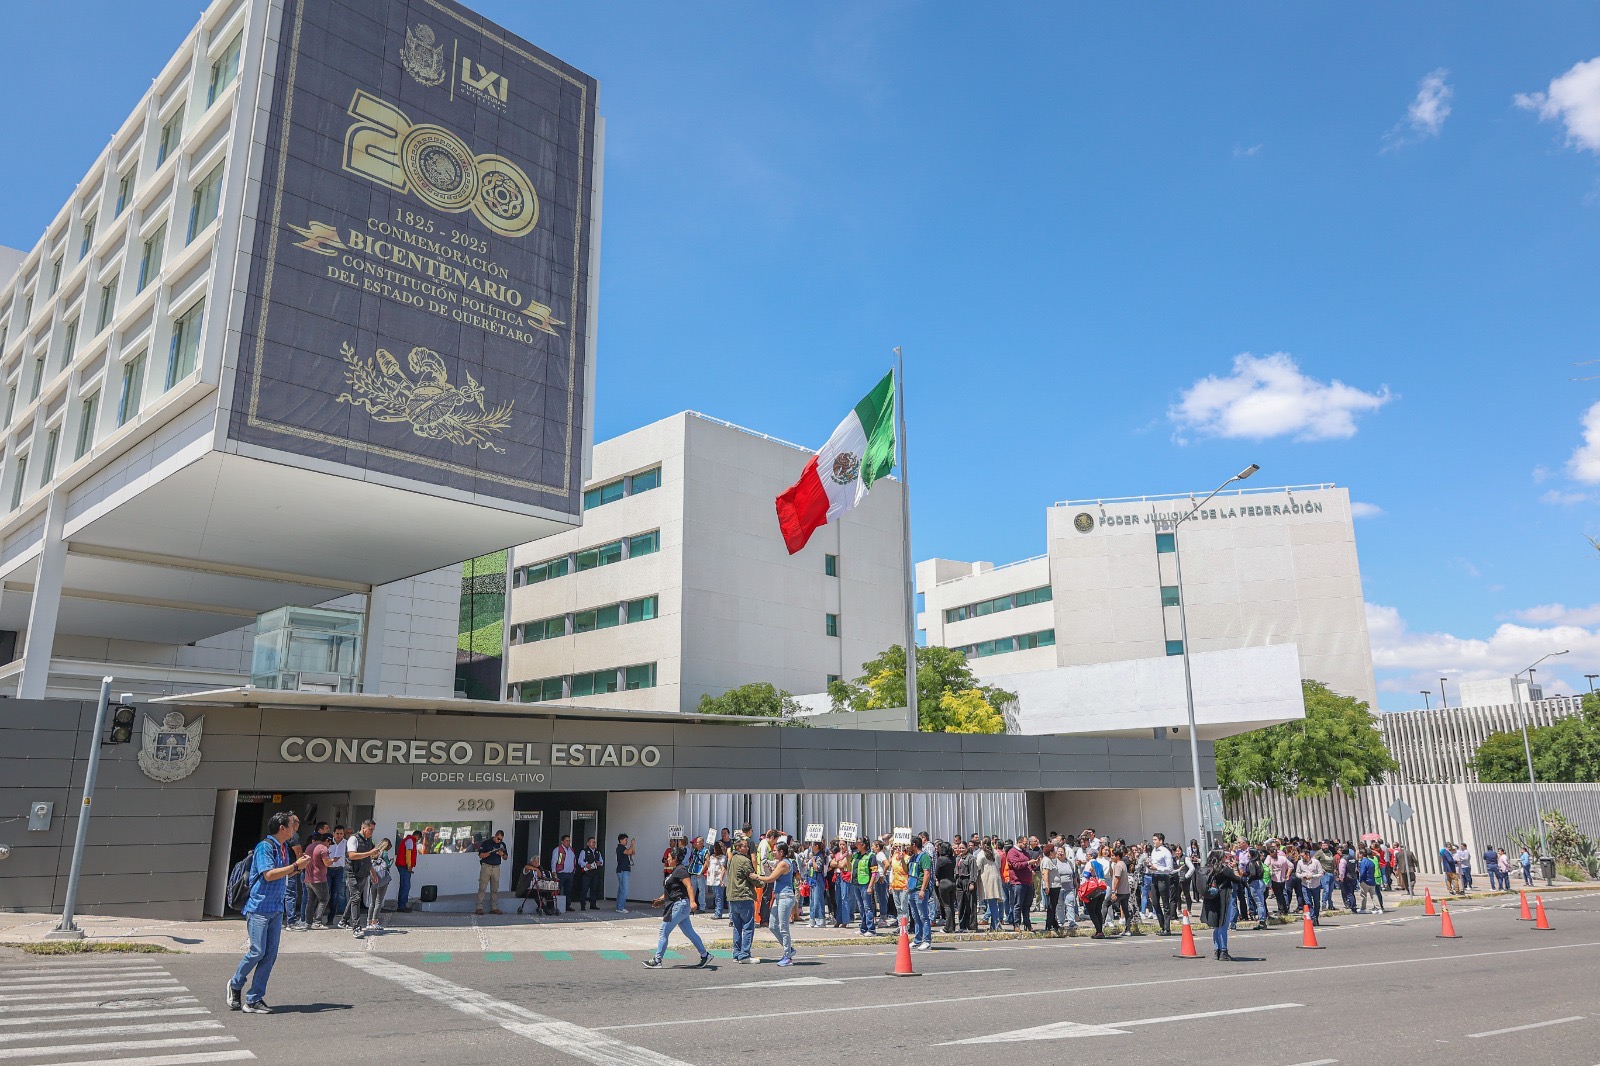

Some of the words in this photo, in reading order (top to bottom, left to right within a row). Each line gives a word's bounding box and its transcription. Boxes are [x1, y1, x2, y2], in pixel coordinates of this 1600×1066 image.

[462, 56, 508, 103] LXI
[367, 217, 509, 280] CONMEMORACIÓN
[395, 208, 434, 233] 1825
[450, 229, 488, 254] 2025
[347, 228, 522, 307] BICENTENARIO
[327, 265, 359, 287] DEL
[362, 277, 424, 307] ESTADO
[428, 300, 449, 317] DE
[452, 308, 534, 344] QUERÉTARO
[342, 255, 458, 304] CONSTITUCIÓN
[461, 296, 524, 327] POLÍTICA
[1099, 514, 1140, 527] PODER
[1144, 510, 1199, 524] JUDICIAL
[1200, 509, 1217, 520] DE
[1220, 507, 1237, 518] LA
[1240, 500, 1323, 517] FEDERACIÓN
[280, 736, 473, 765] CONGRESO
[483, 742, 541, 766] DEL
[551, 743, 661, 767] ESTADO
[420, 771, 465, 783] PODER
[468, 772, 545, 783] LEGISLATIVO
[457, 798, 496, 813] 2920
